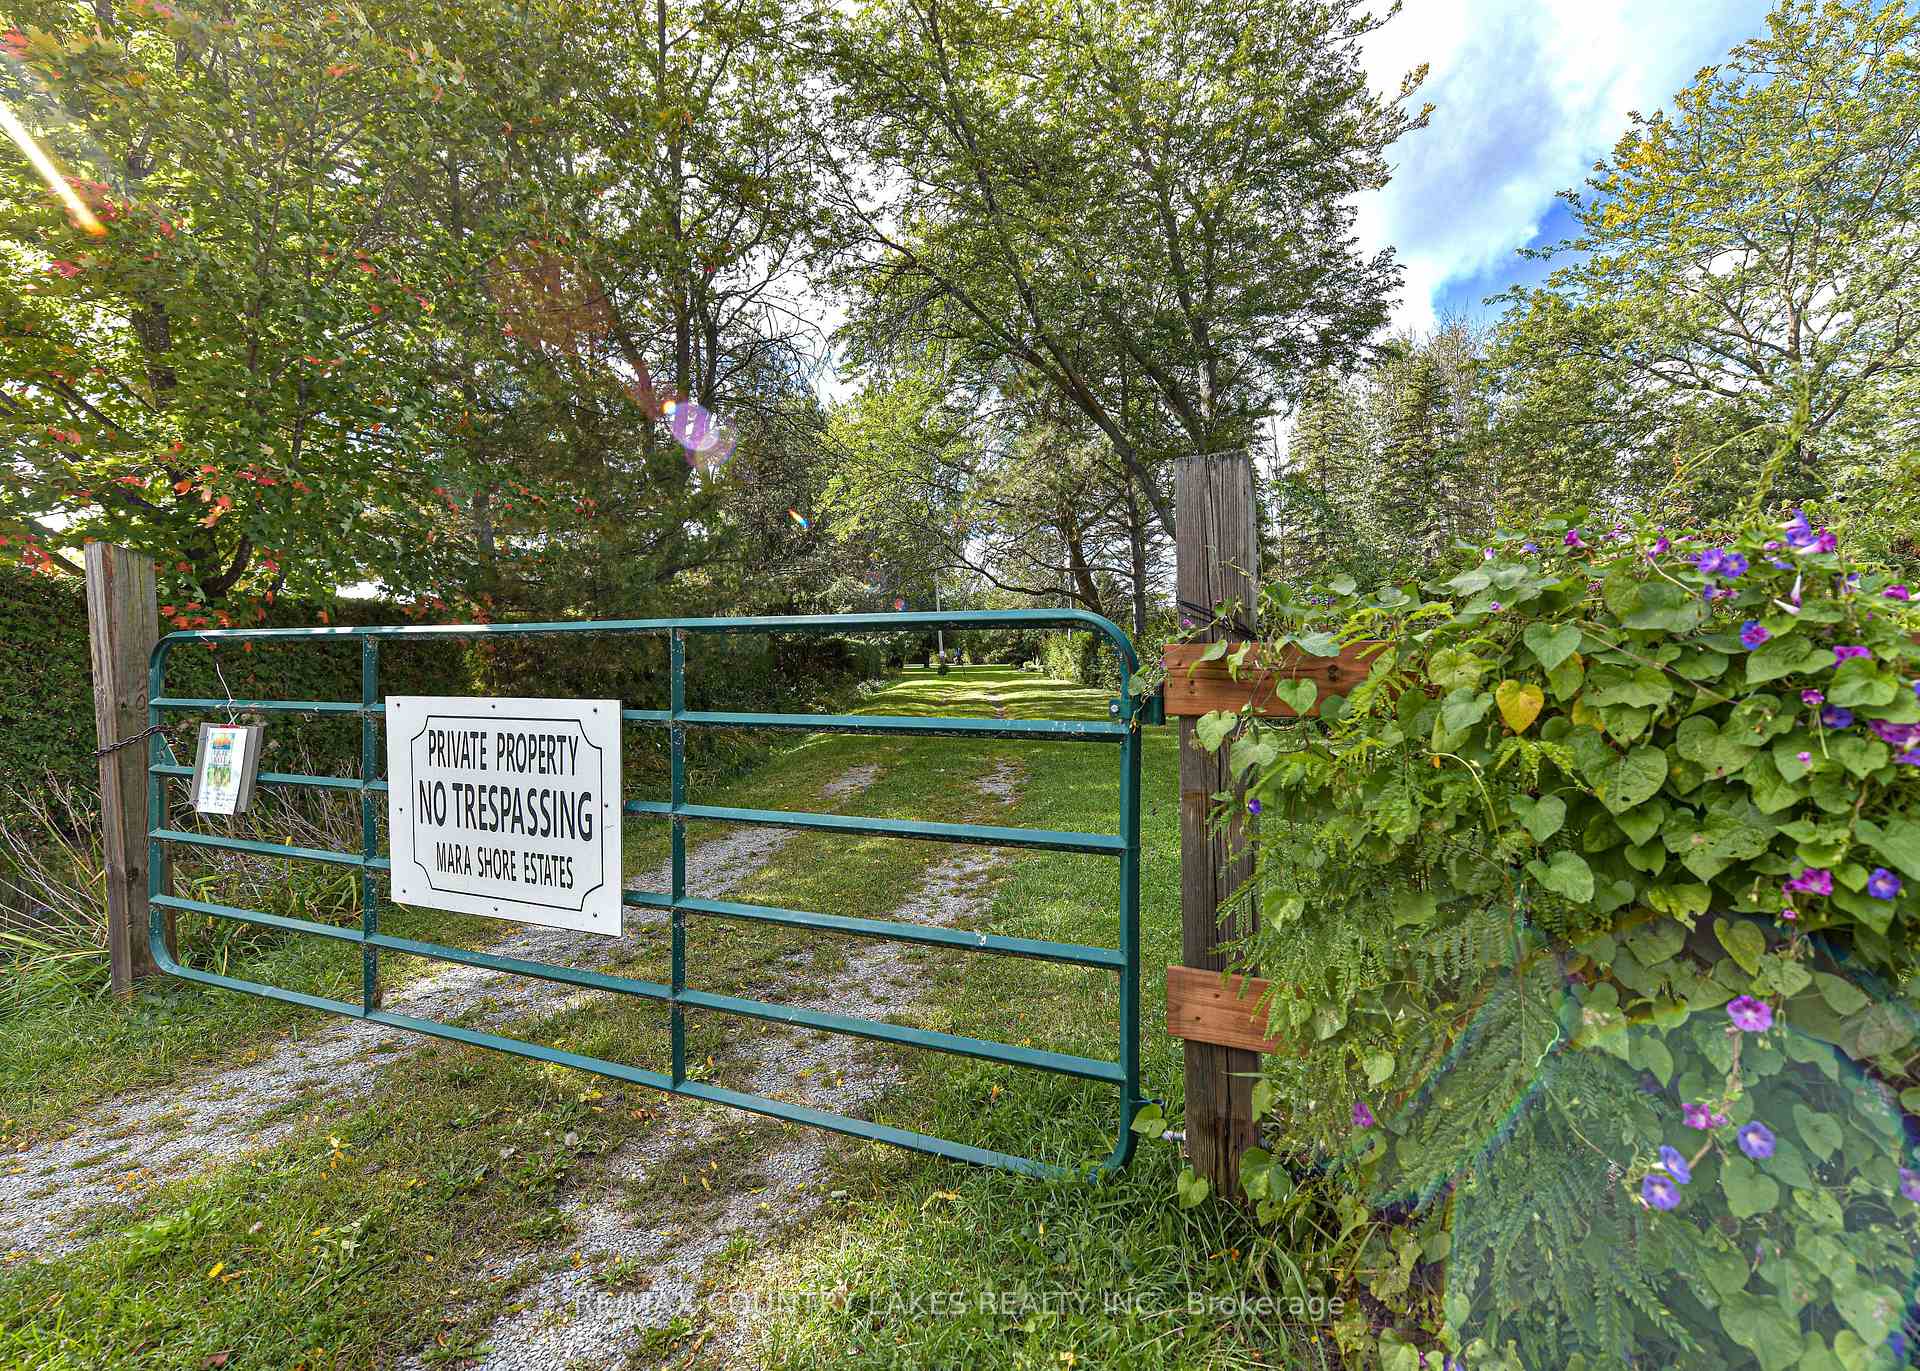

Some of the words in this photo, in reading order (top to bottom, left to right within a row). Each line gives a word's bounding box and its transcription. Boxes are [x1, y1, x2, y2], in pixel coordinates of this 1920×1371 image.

[428, 729, 487, 771] PRIVATE
[496, 731, 579, 776] PROPERTY
[419, 780, 447, 827] NO
[452, 782, 593, 842] TRESPASSING
[436, 841, 472, 876] MARA
[478, 845, 517, 882] SHORE
[523, 852, 574, 890] ESTATES
